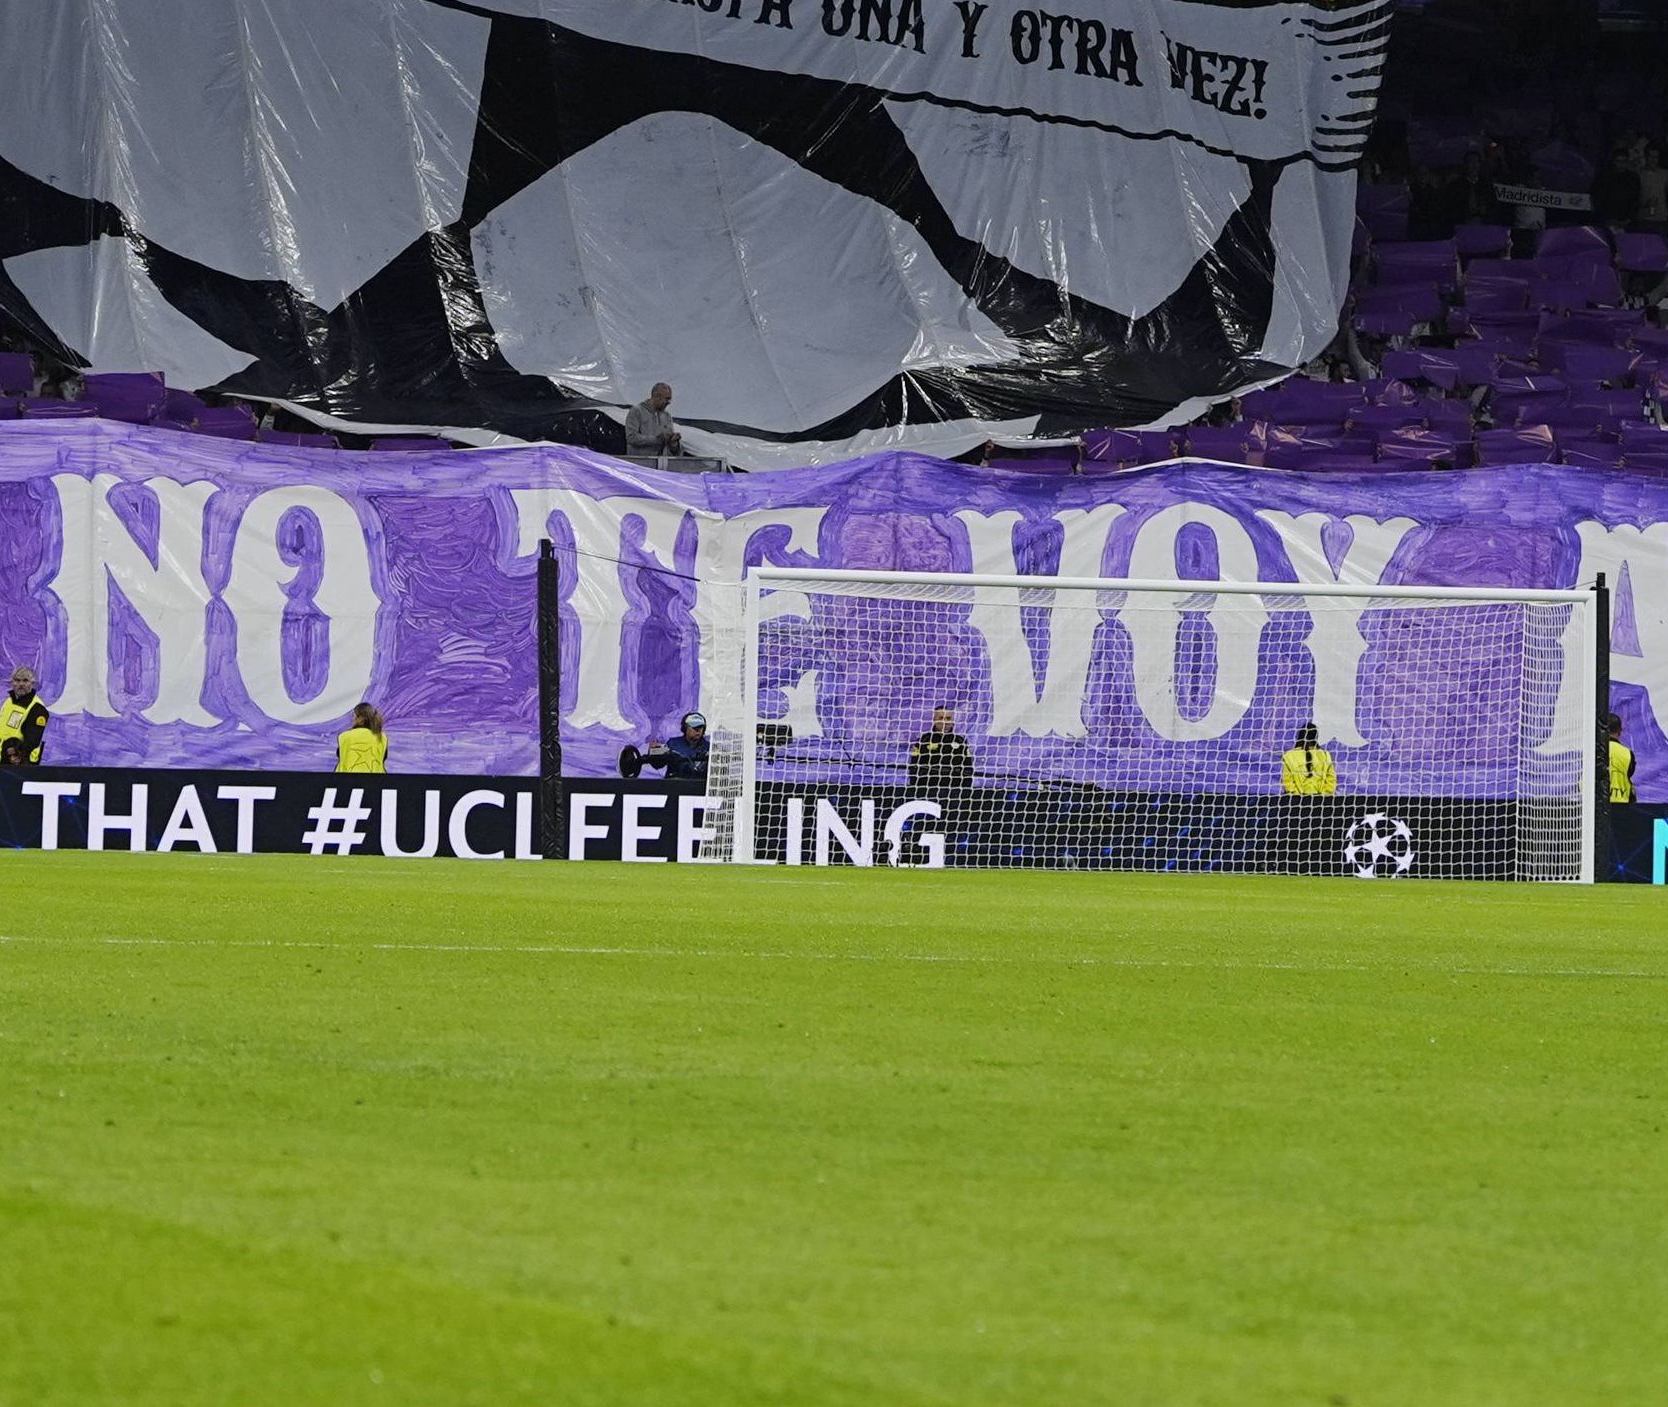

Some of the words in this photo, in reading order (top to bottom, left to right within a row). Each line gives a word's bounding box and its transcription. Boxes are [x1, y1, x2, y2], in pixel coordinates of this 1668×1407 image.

[952, 0, 989, 59] Y
[1009, 9, 1144, 88] OTRA
[1164, 35, 1269, 120] VEZ!
[46, 471, 386, 730] NO
[502, 484, 831, 738] TE
[947, 501, 1426, 749] VOY
[21, 781, 277, 855] THAT
